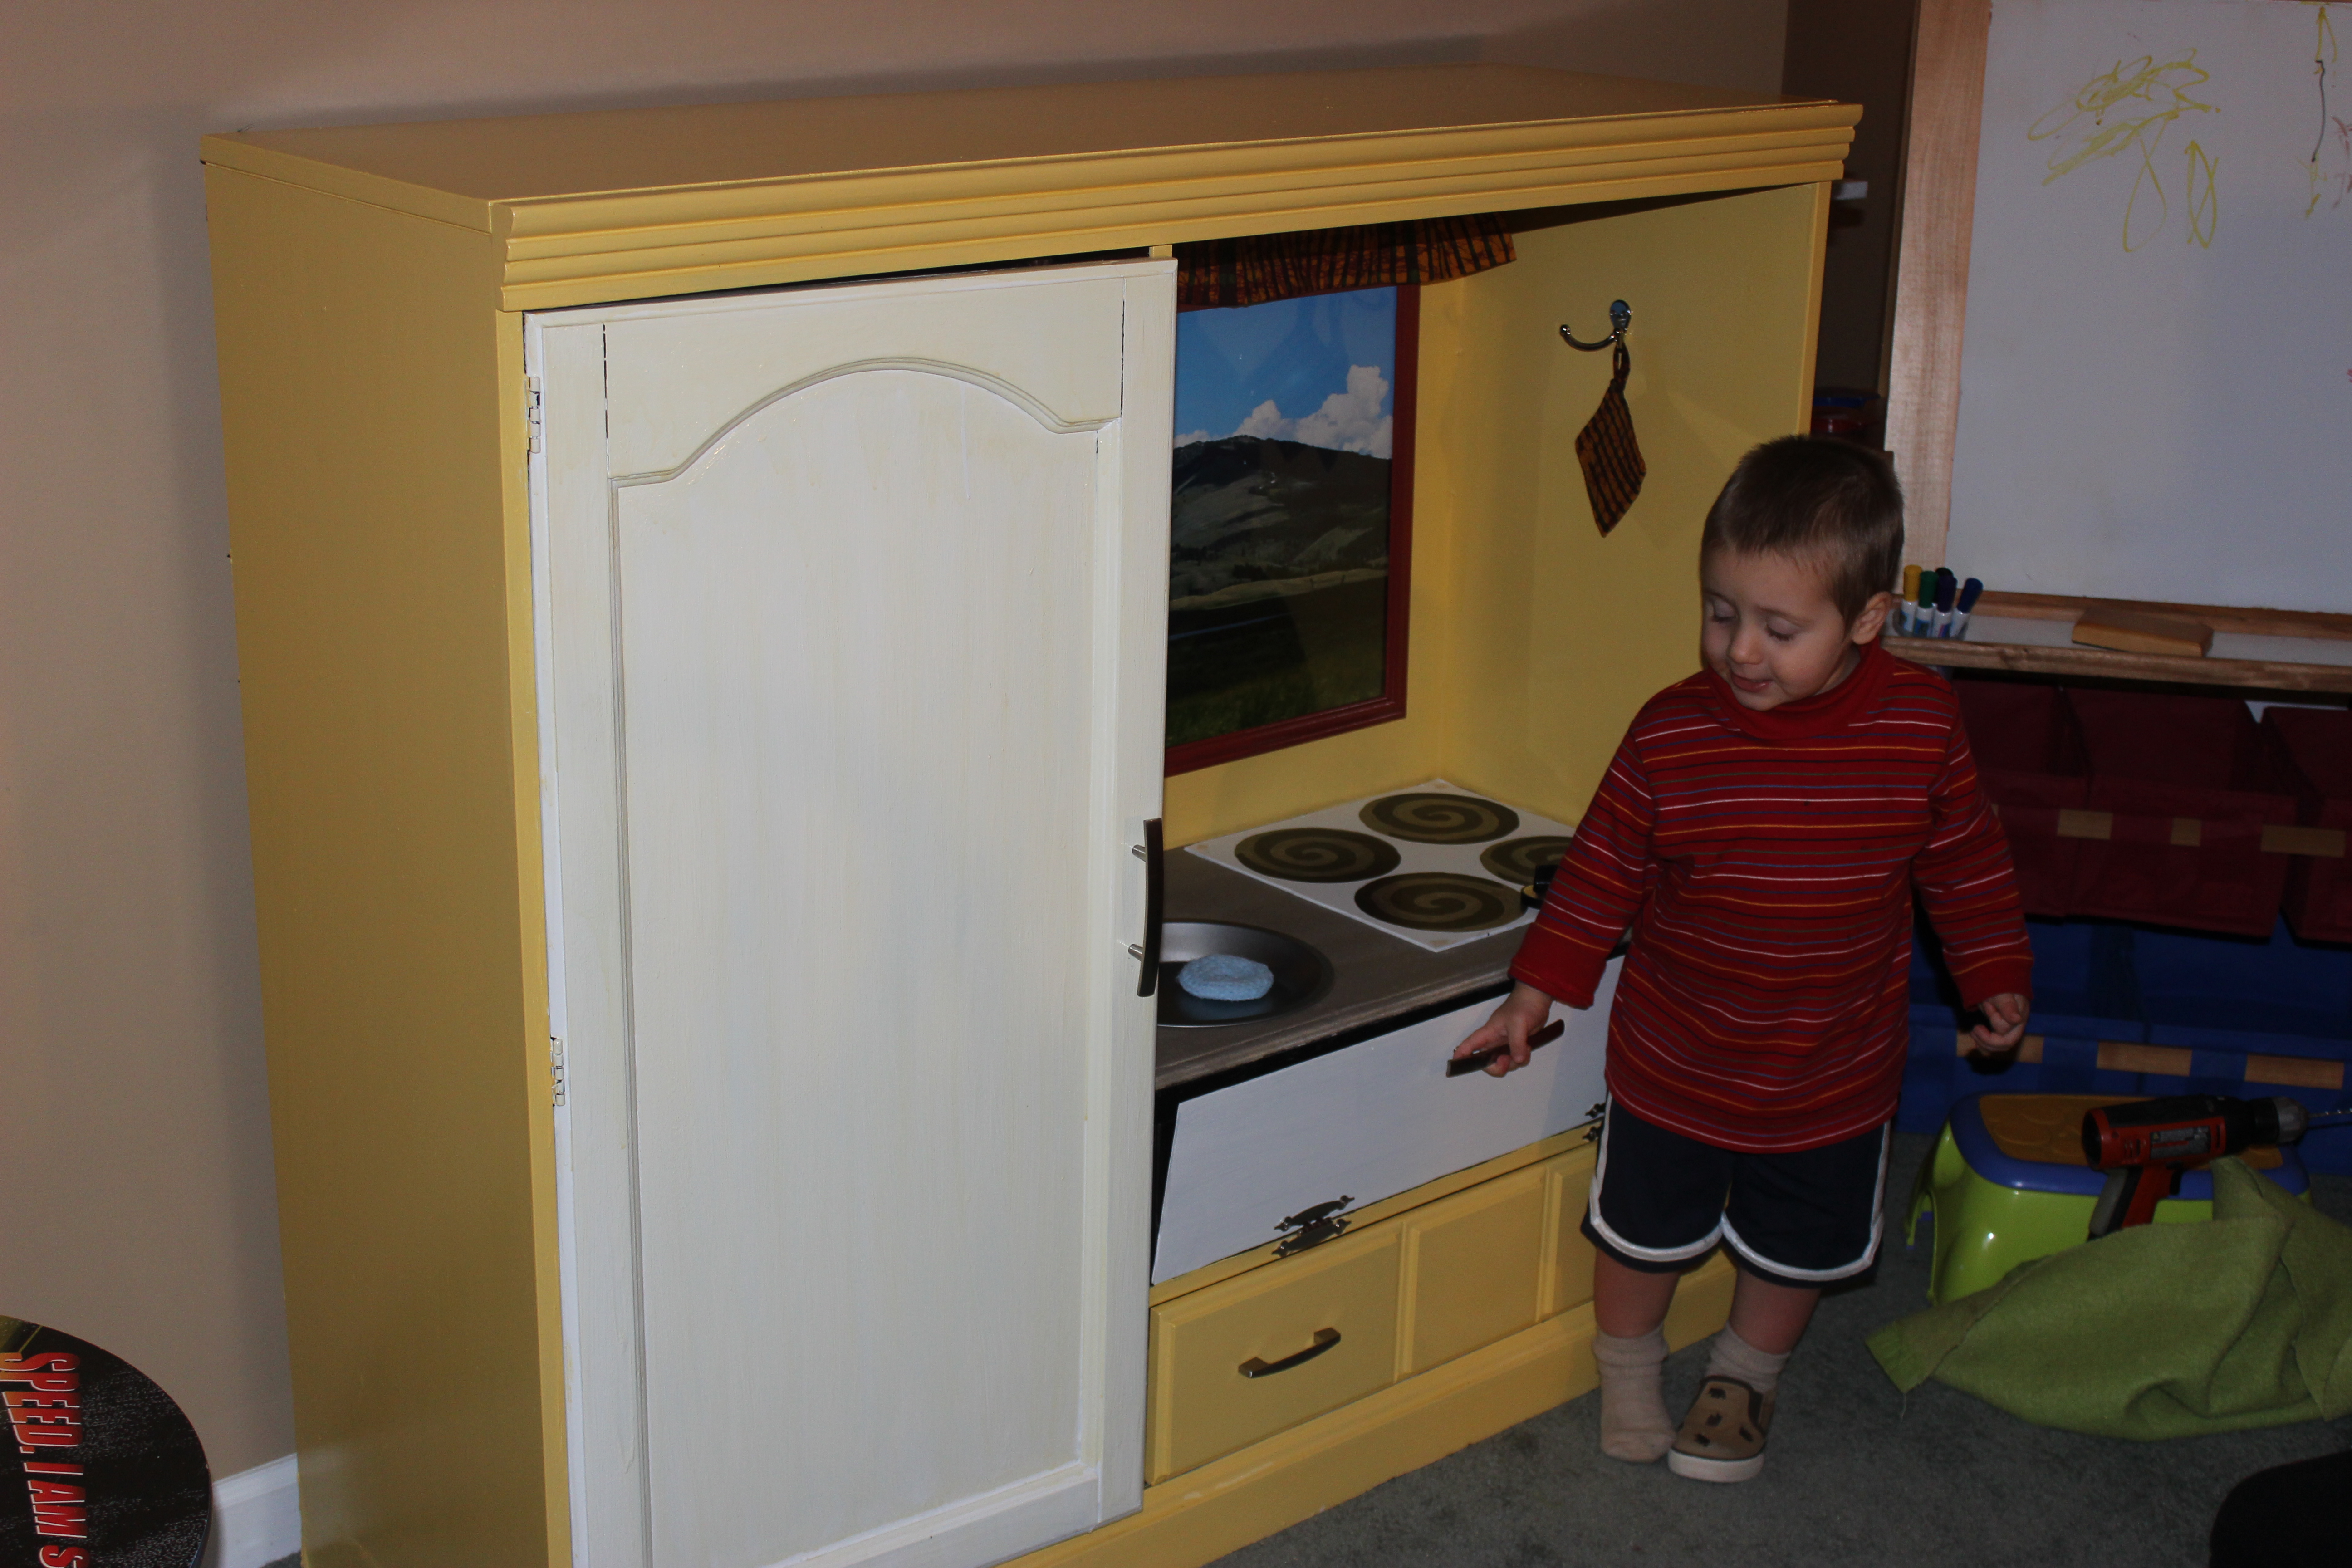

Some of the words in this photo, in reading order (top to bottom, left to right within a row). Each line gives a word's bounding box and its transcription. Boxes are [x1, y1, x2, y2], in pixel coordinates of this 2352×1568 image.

[0, 1352, 83, 1454] SPEED.
[23, 1462, 84, 1475] I
[27, 1480, 88, 1538] AM
